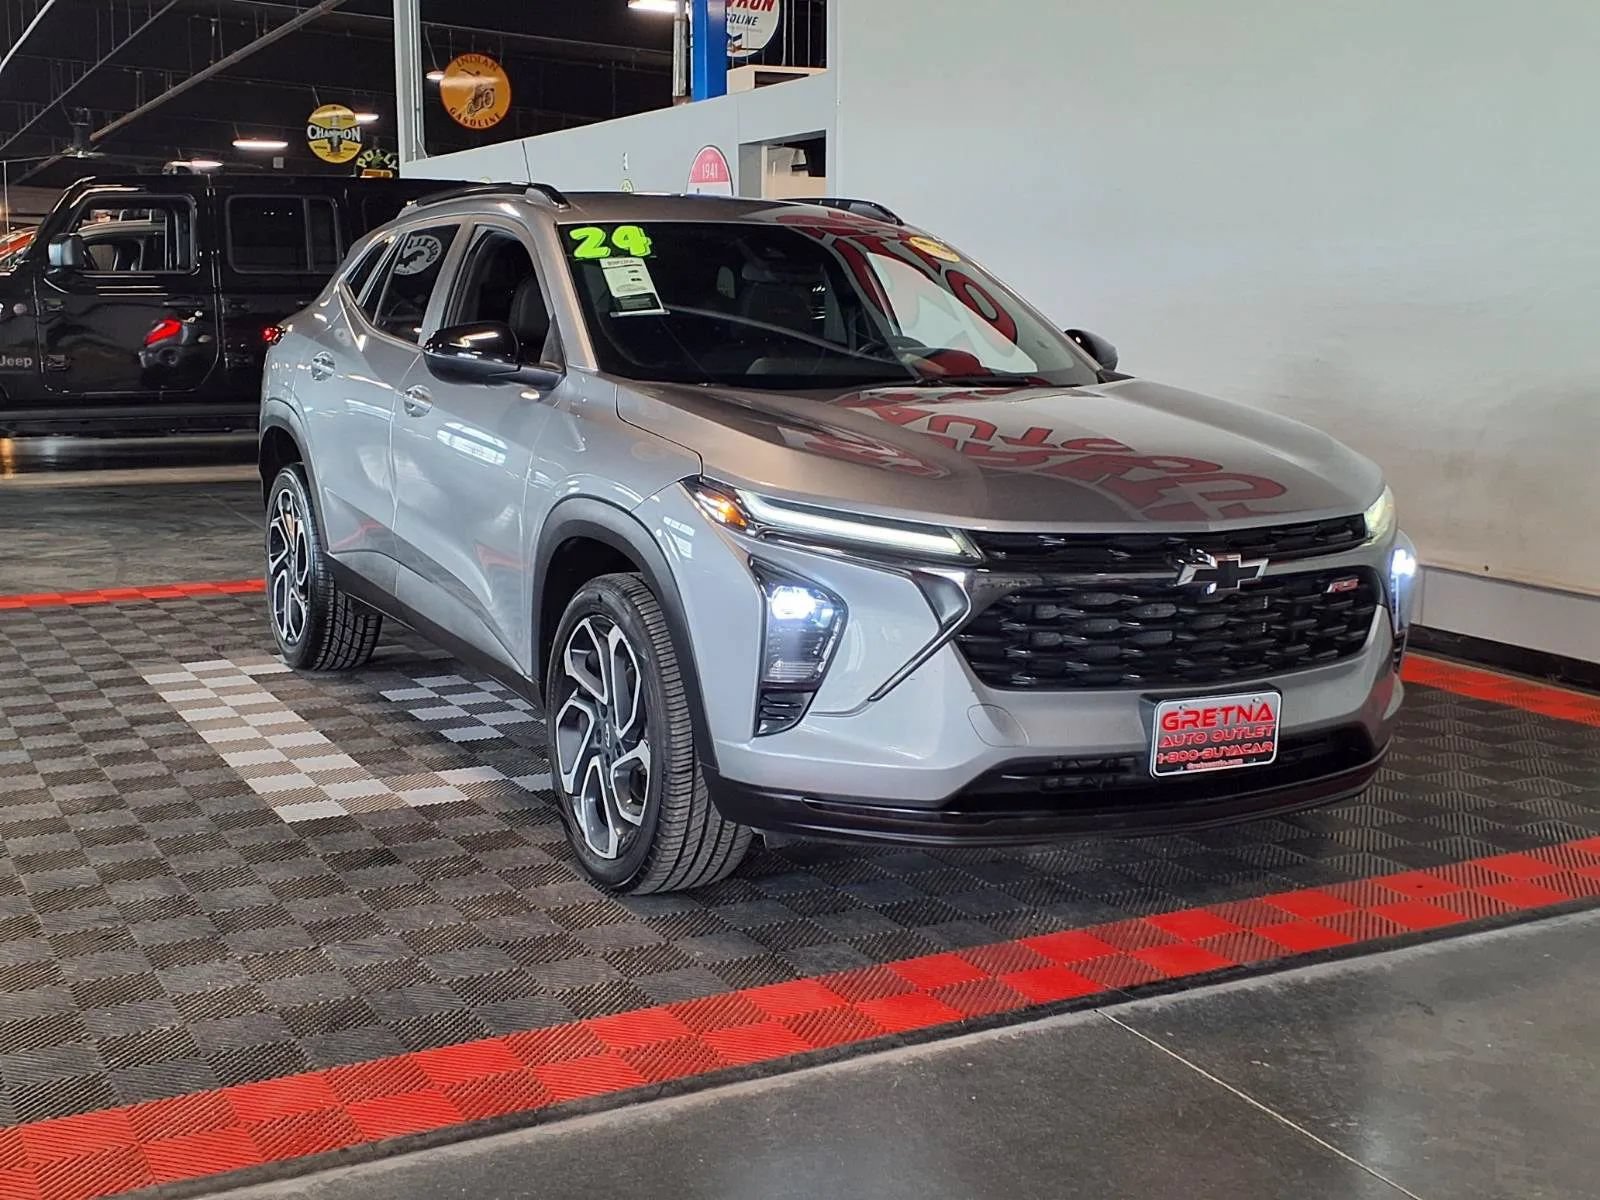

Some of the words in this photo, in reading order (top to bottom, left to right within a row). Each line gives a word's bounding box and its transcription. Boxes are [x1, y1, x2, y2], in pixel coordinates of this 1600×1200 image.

[727, 14, 759, 26] OLINE
[456, 56, 498, 71] INDIAN
[702, 163, 718, 179] 1941
[569, 225, 653, 258] 24
[0, 355, 32, 368] Jeep
[1161, 702, 1275, 733] GRETNA
[1159, 731, 1208, 748] AUTO
[1211, 725, 1275, 743] OUTLET
[1157, 741, 1274, 764] 1-800-BUYACAR
